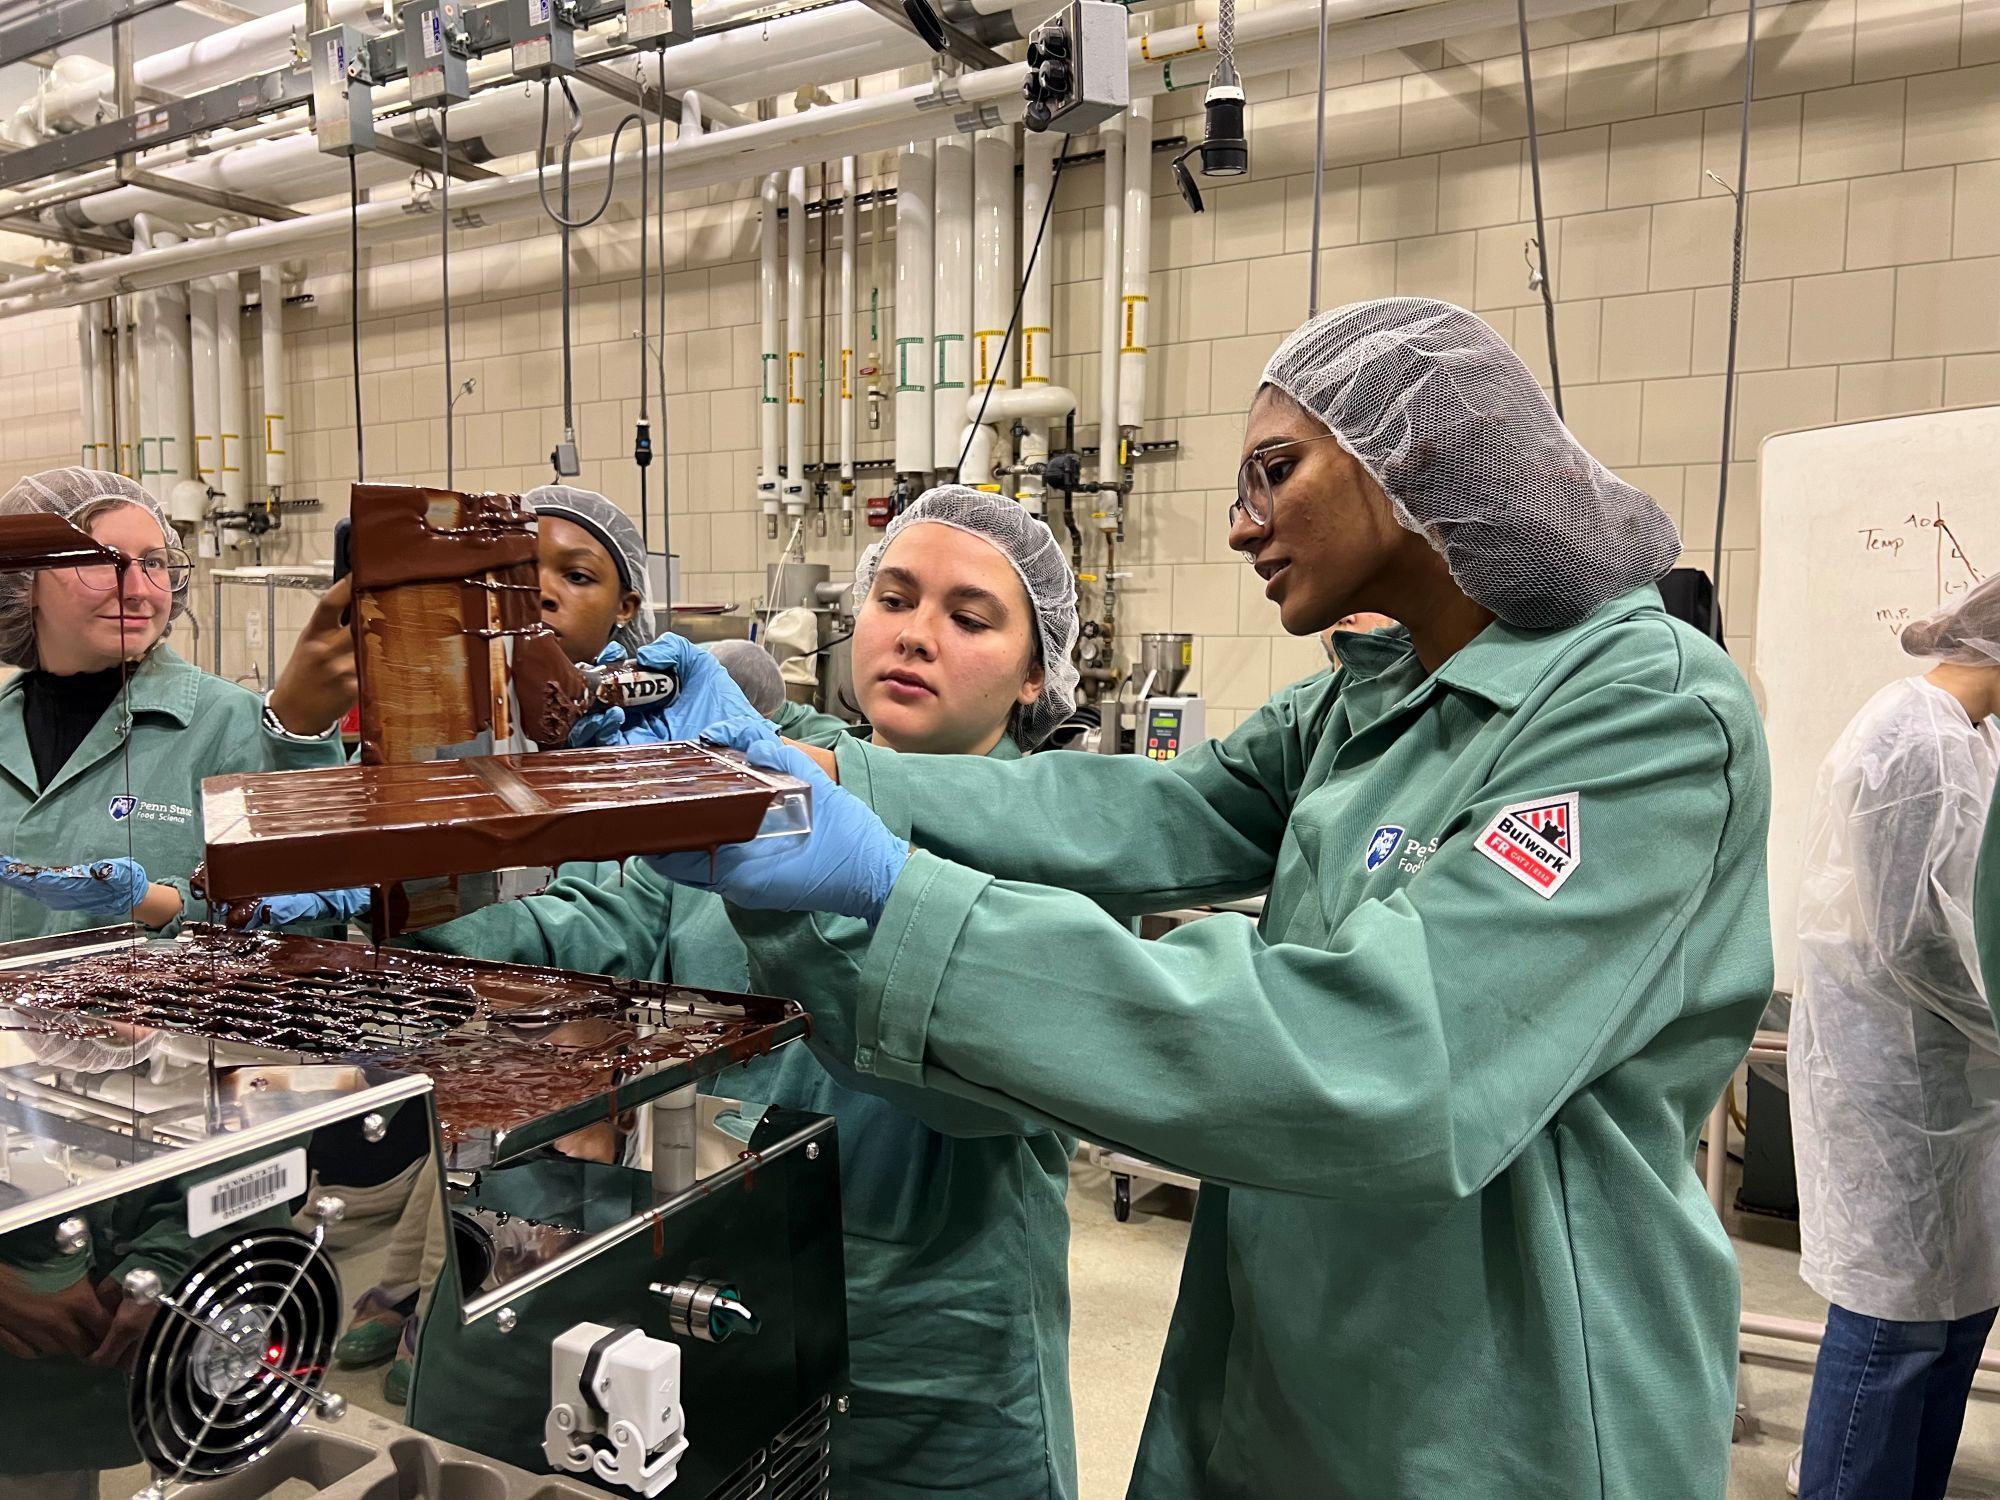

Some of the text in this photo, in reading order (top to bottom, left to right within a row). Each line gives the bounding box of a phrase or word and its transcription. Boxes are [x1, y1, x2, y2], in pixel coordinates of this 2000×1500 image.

[1858, 528, 1904, 557] Temp
[612, 678, 668, 699] YDE
[140, 801, 168, 812] Penn
[136, 811, 185, 824] Food Science
[1490, 837, 1511, 855] FR
[1497, 817, 1567, 874] Bulwark
